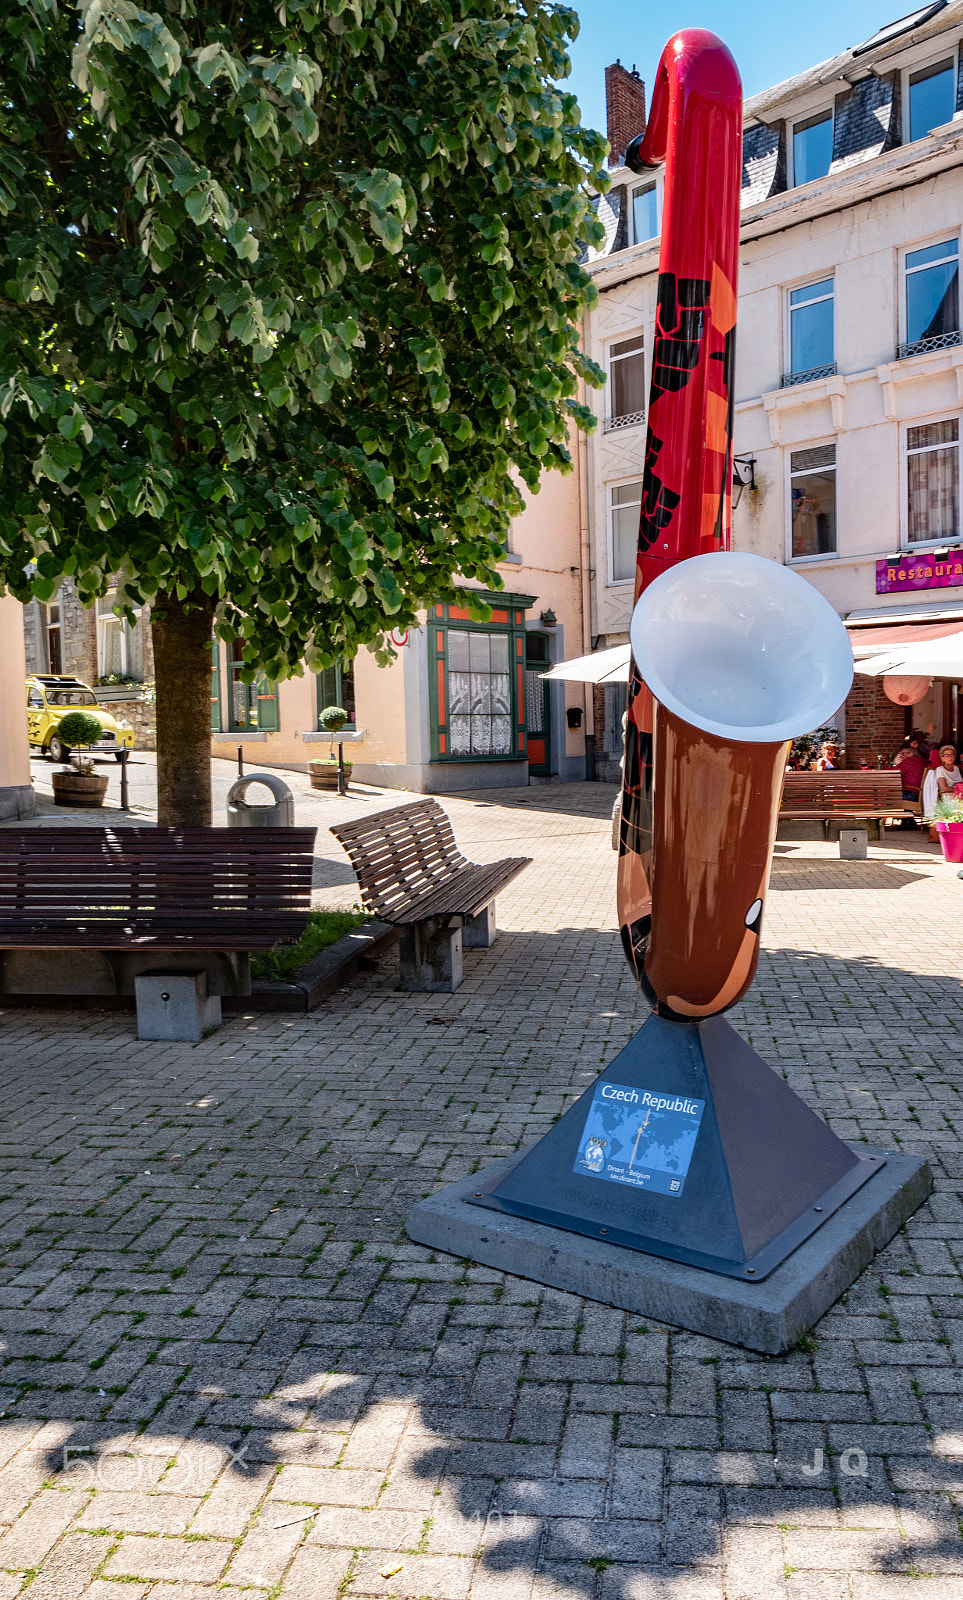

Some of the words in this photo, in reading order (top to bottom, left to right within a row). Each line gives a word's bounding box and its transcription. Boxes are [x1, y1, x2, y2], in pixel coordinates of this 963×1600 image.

[887, 563, 963, 582] Restaura
[601, 1085, 639, 1103] Czech
[641, 1092, 698, 1115] Republic
[607, 1164, 625, 1174] Dinant
[628, 1169, 651, 1180] Belgium
